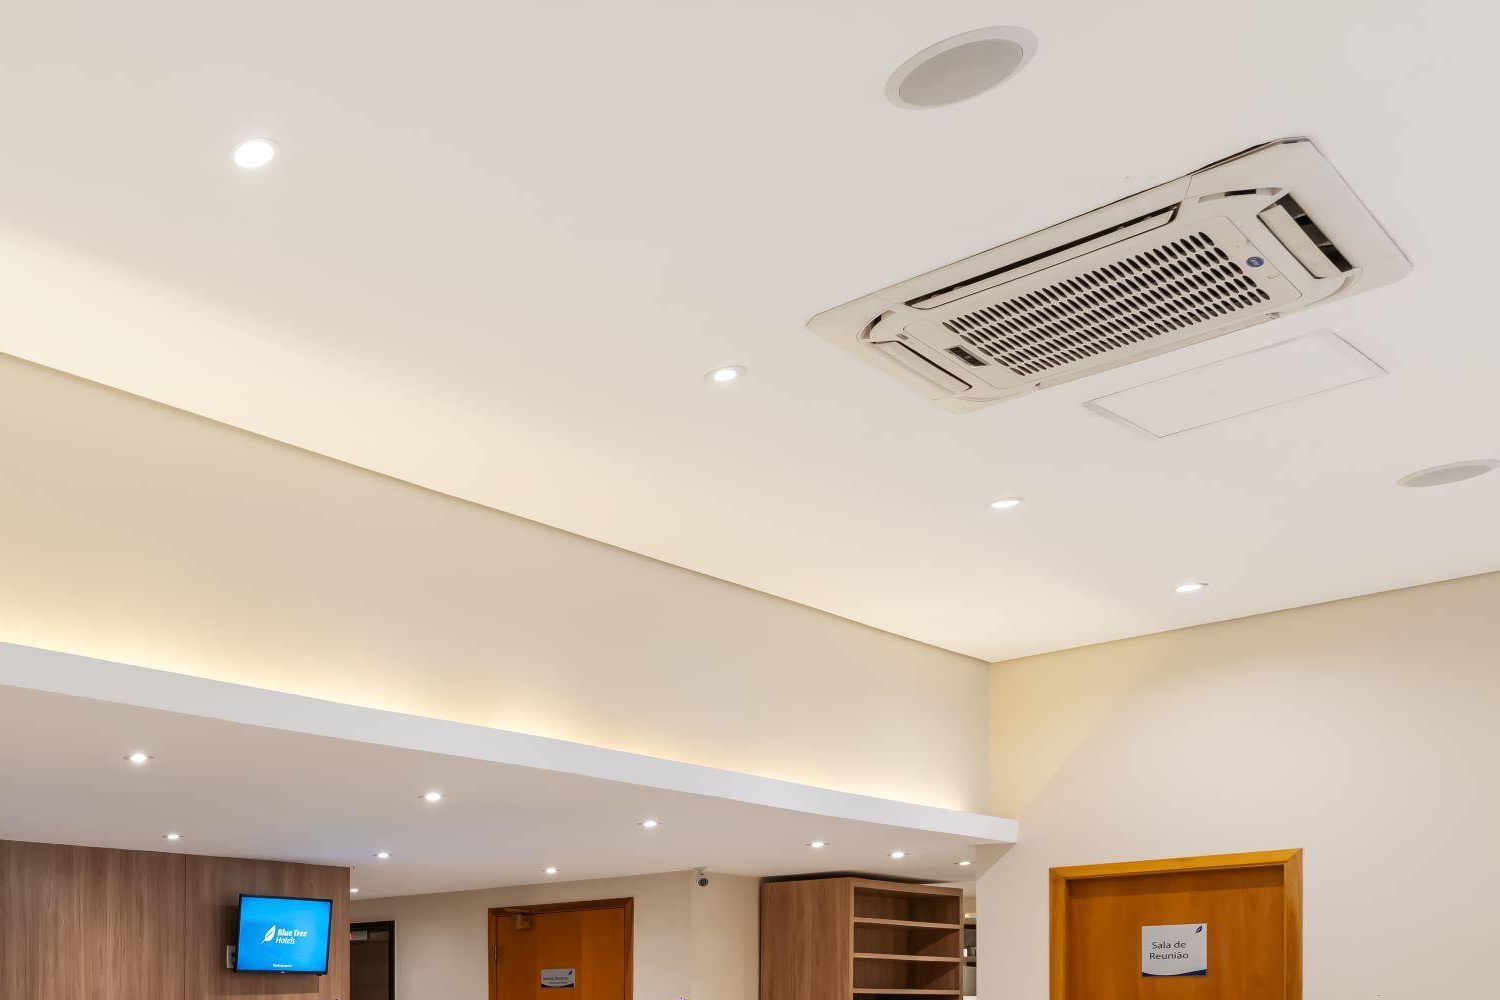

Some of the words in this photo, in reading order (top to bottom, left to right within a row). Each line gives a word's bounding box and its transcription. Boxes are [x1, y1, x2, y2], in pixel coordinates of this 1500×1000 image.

[277, 929, 293, 937] Blue
[293, 929, 308, 937] Tree
[275, 937, 296, 945] Hotels
[1151, 941, 1171, 949] Sala
[1173, 941, 1187, 949] de
[1149, 952, 1189, 960] Reunião
